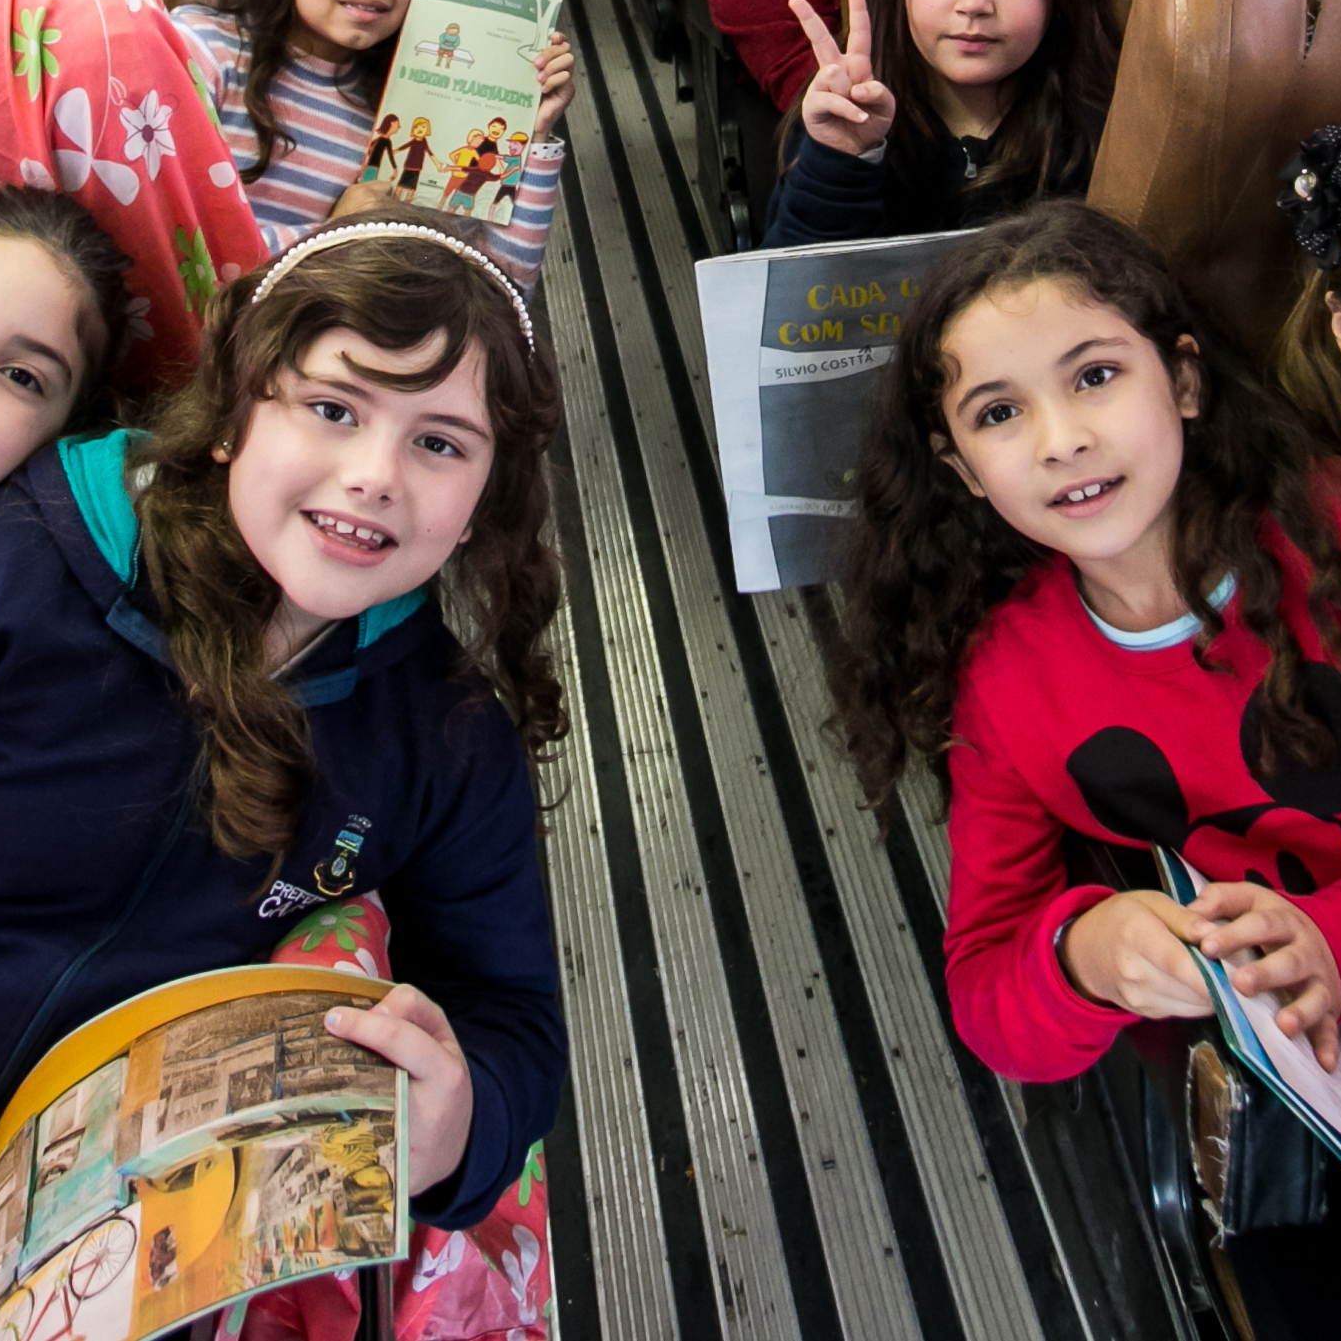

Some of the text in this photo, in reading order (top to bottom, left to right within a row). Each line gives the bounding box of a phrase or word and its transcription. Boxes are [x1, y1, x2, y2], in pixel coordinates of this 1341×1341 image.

[807, 281, 886, 311] CADA
[778, 319, 844, 346] COM
[775, 353, 875, 379] SILVIO COSTTA
